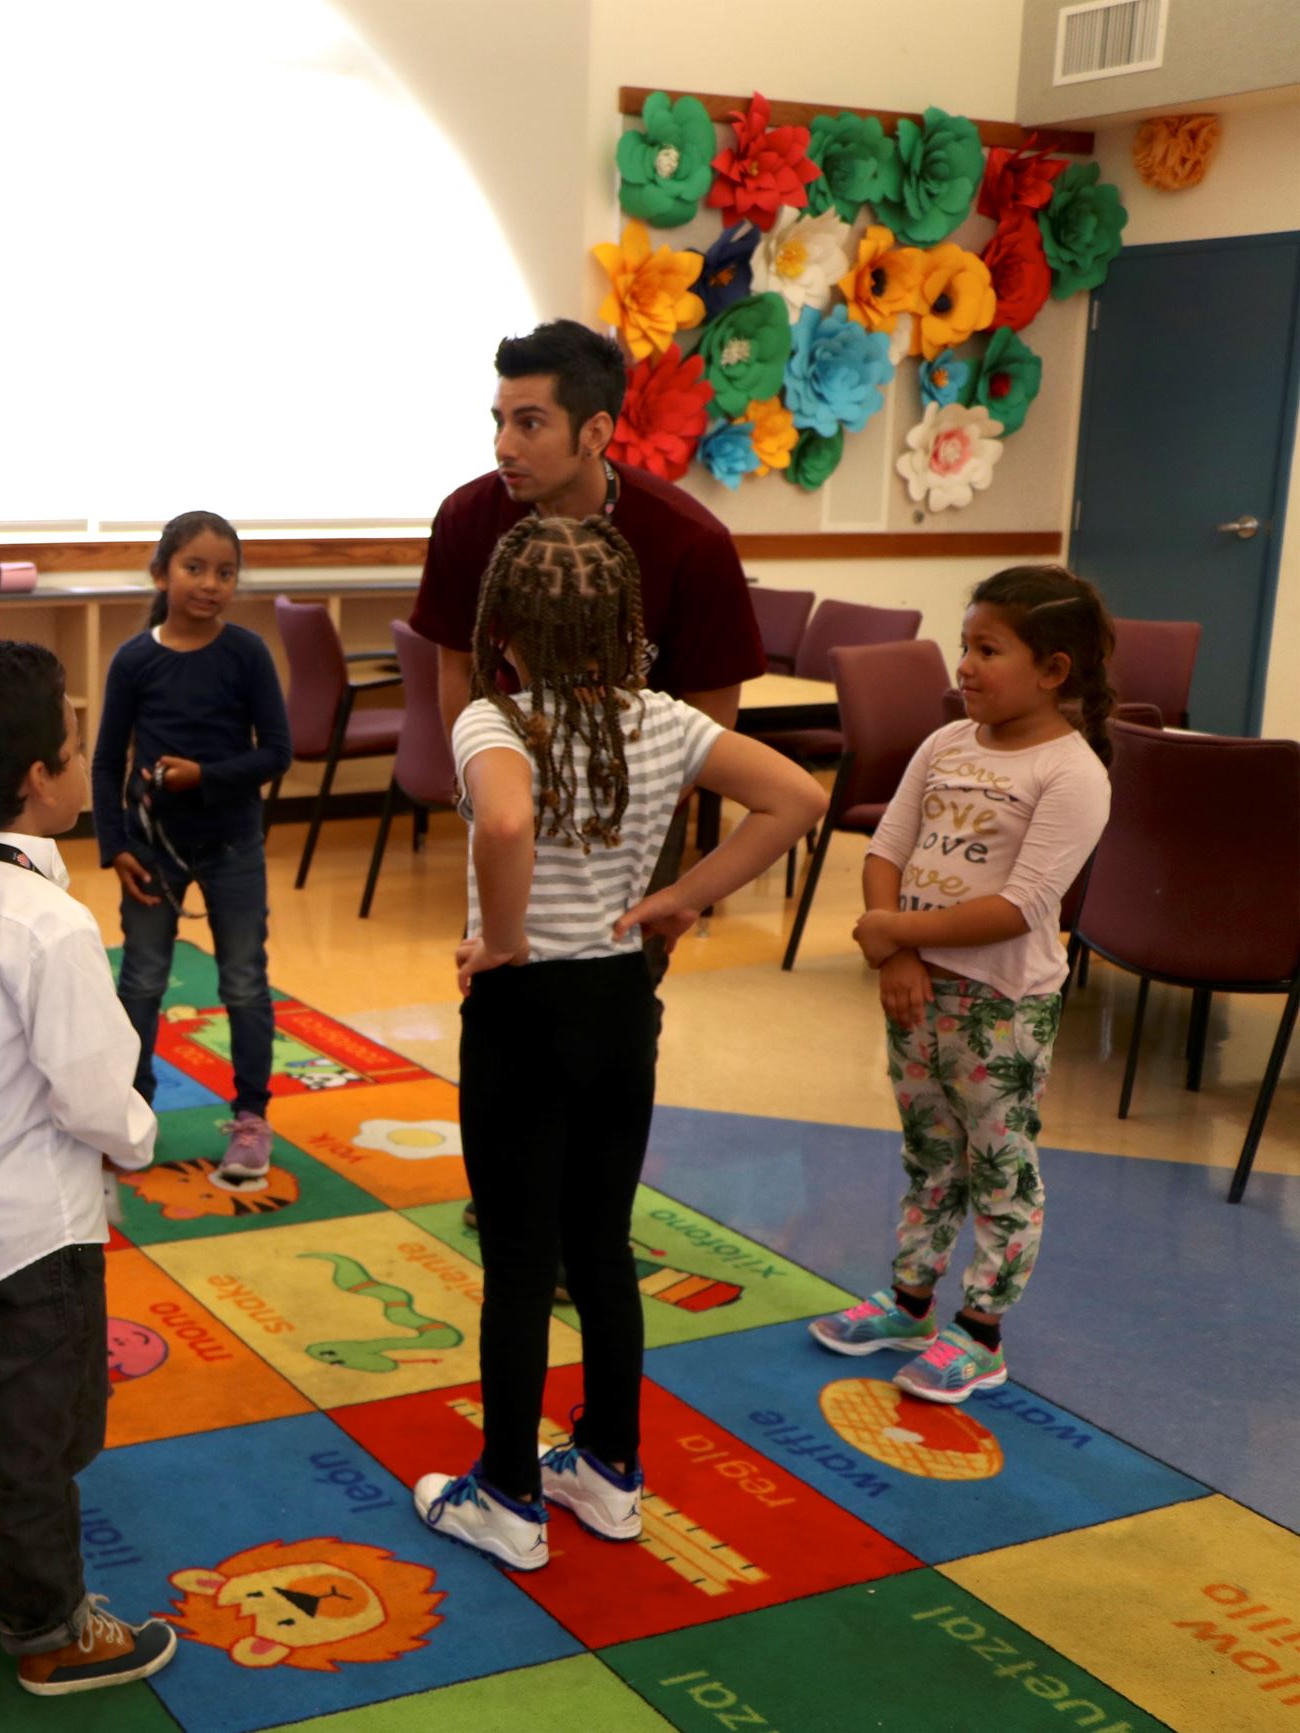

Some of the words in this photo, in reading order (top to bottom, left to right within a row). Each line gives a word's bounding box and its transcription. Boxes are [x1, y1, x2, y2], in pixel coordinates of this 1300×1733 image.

[923, 793, 1000, 835] ove
[917, 831, 990, 865] ove
[148, 1301, 235, 1364] mono
[206, 1273, 297, 1336] snake
[966, 1386, 1094, 1451] waff
[308, 1449, 396, 1515] león
[676, 1433, 797, 1510] regla
[747, 1409, 893, 1499] waffle
